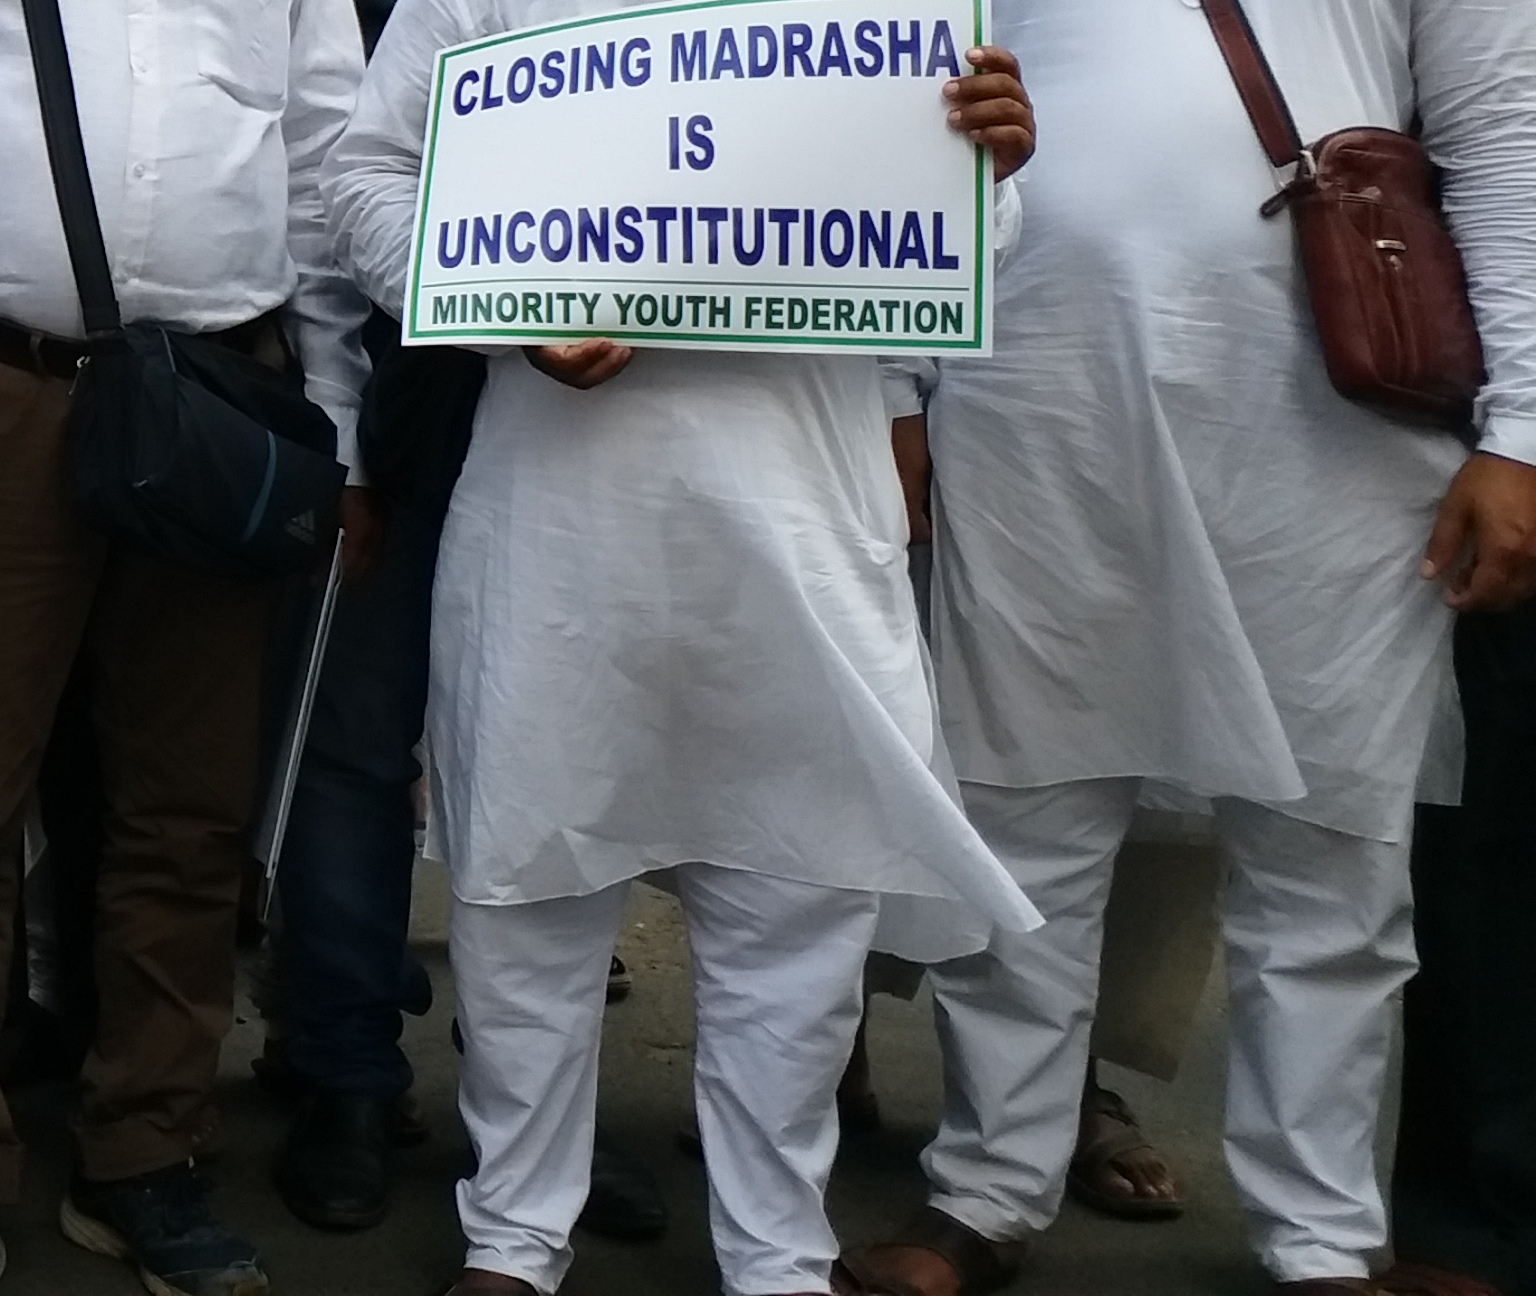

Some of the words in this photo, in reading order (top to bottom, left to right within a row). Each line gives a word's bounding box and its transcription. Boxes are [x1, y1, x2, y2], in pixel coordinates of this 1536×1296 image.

[454, 37, 652, 116] CLOSING
[670, 19, 960, 82] MADRASHA
[668, 116, 714, 170] IS
[436, 206, 960, 270] UNCONSTITUTIONAL
[432, 292, 602, 326] MINORITY
[612, 293, 730, 329] YOUTH
[744, 297, 963, 335] FEDERATION
